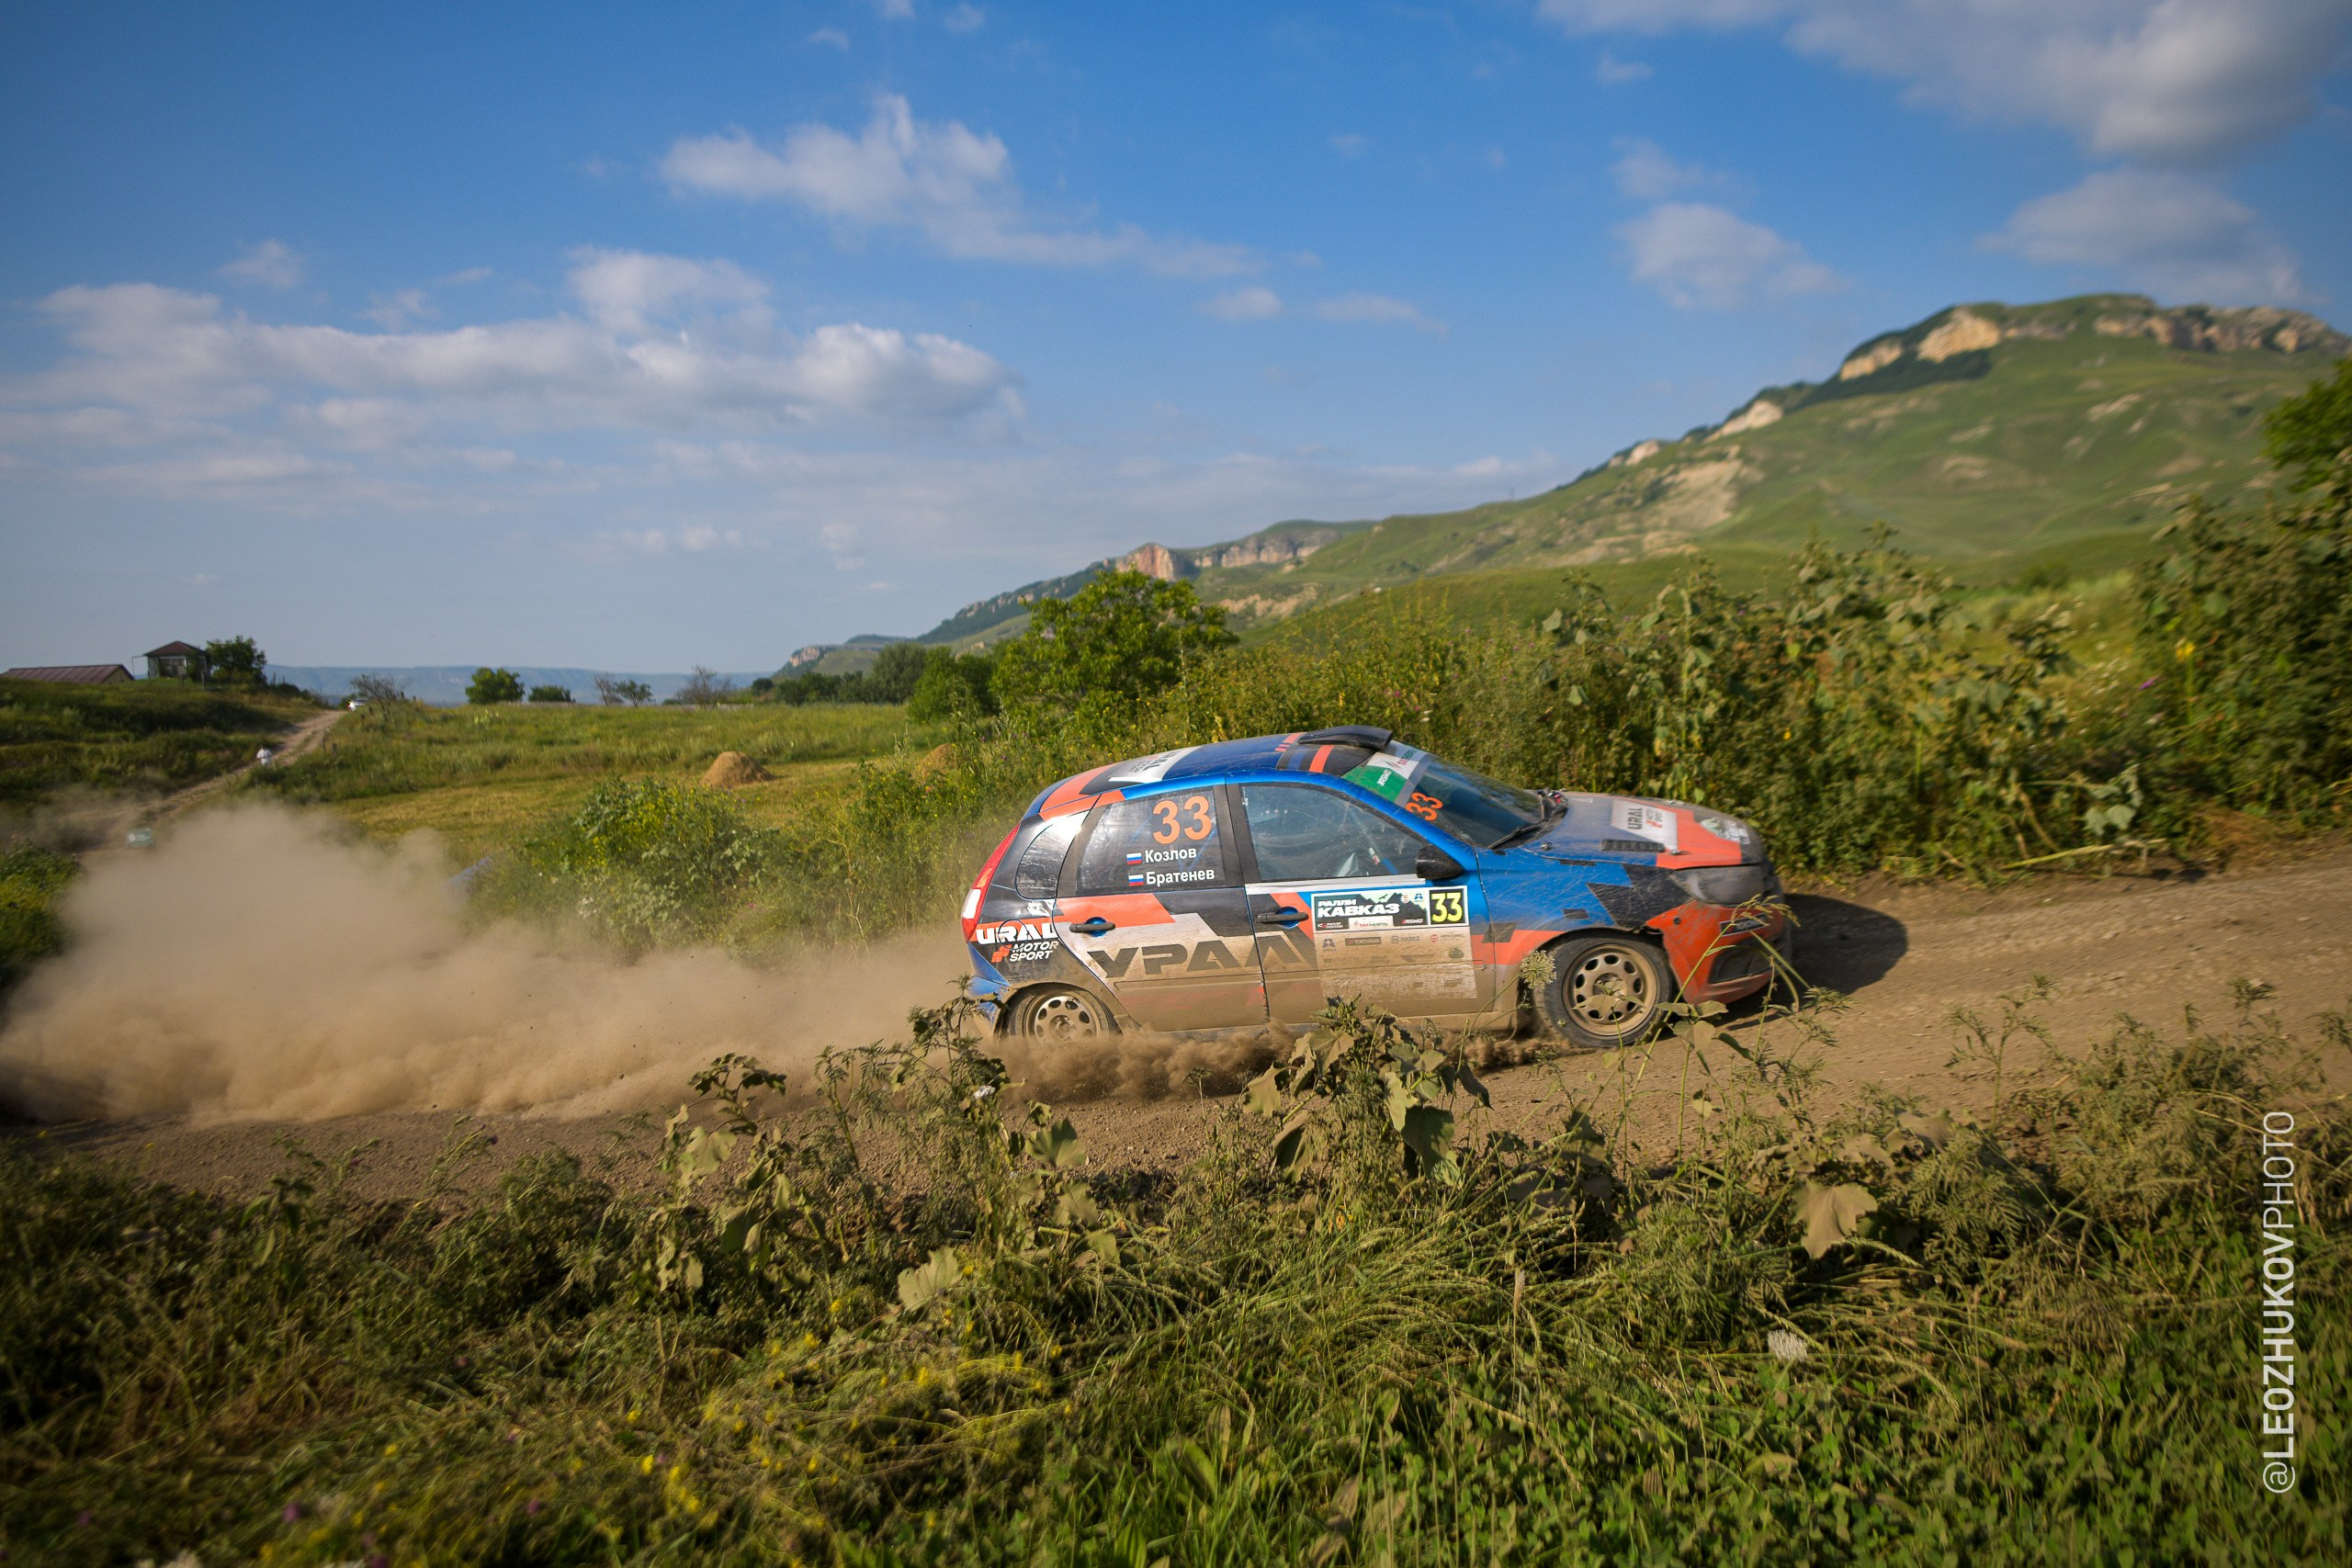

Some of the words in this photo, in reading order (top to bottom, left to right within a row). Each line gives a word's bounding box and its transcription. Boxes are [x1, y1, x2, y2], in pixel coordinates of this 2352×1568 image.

[1406, 792, 1443, 821] 33
[1153, 795, 1212, 844] 33
[1627, 807, 1643, 829] URAL
[1145, 848, 1197, 863] Козлов
[1146, 869, 1216, 886] Братенев
[1317, 903, 1400, 918] КАВКАЗ
[1431, 893, 1463, 922] 33
[976, 922, 1058, 944] URAL
[1010, 950, 1053, 962] SPORT
[1012, 941, 1058, 953] MOTOR
[1087, 934, 1303, 979] УРАЛ
